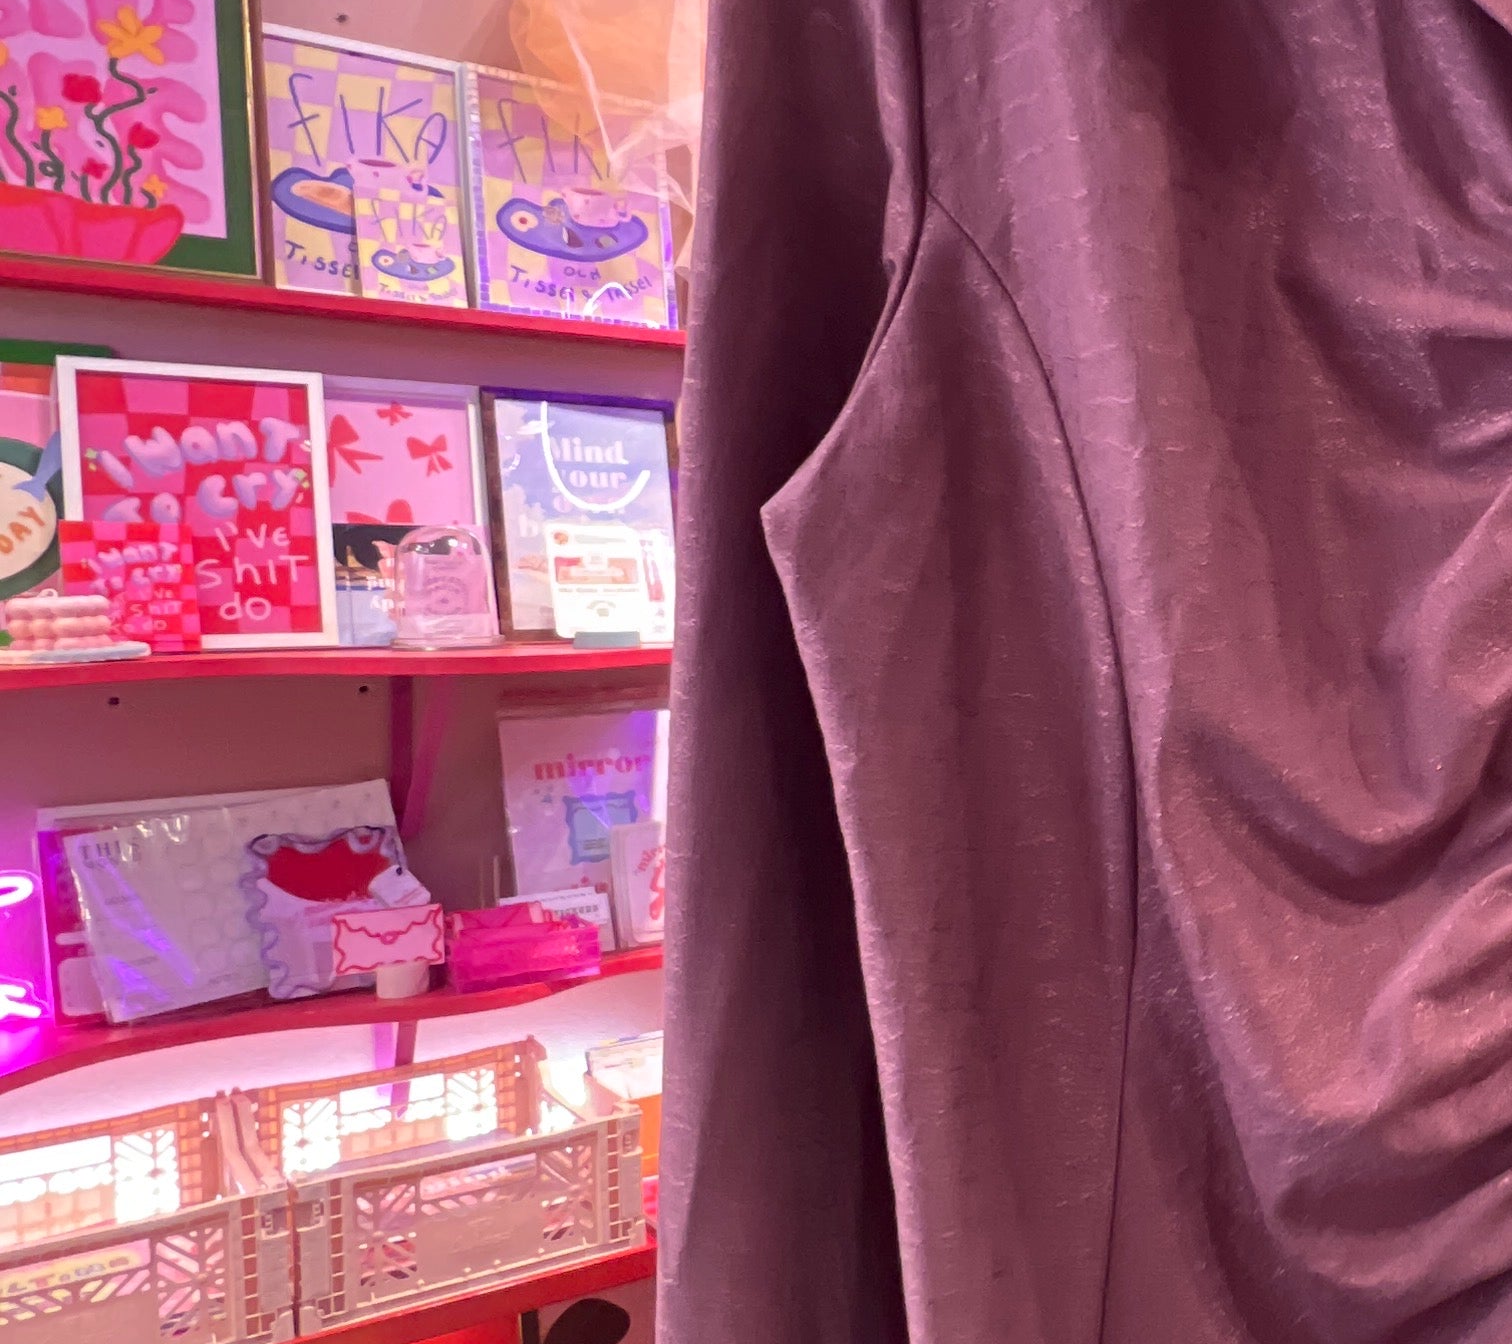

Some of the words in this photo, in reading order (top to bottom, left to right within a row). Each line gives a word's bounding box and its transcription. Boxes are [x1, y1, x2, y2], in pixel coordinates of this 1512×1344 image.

[288, 72, 448, 168] FIKA
[496, 97, 622, 184] FIK
[551, 468, 627, 493] our
